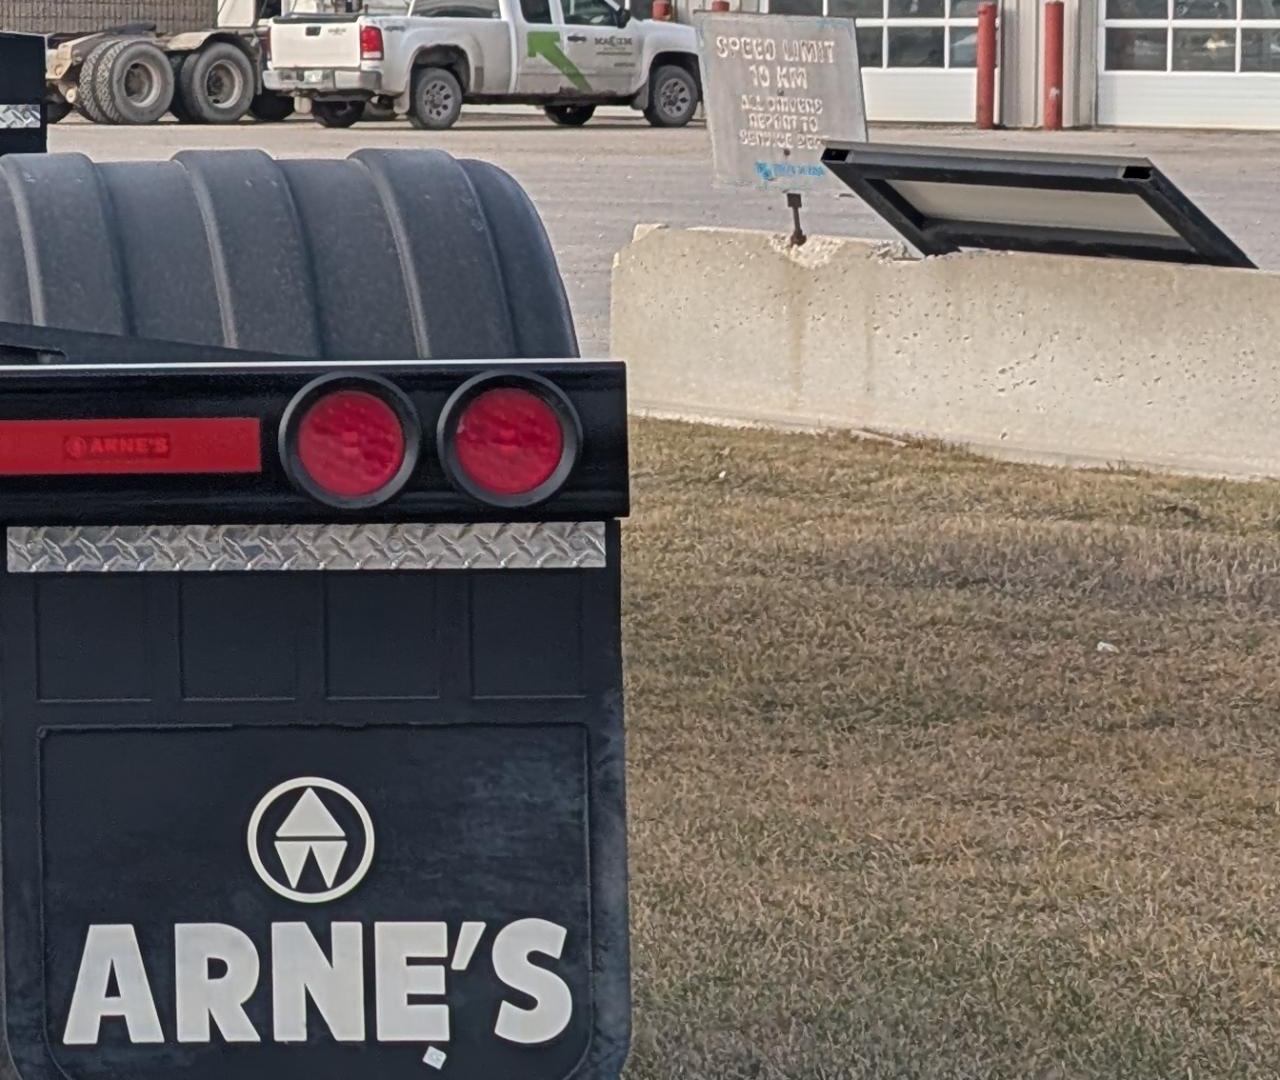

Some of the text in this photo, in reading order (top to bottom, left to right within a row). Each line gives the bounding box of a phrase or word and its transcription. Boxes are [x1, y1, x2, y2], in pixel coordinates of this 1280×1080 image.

[716, 36, 836, 64] SPEED LIMIT
[749, 65, 808, 90] 10 KM
[741, 94, 824, 115] ALL DRIVERS
[748, 113, 819, 132] REPORT TO
[740, 130, 794, 149] SERVICE
[90, 436, 169, 455] ARNE'S
[62, 917, 574, 1046] ARNE'S
